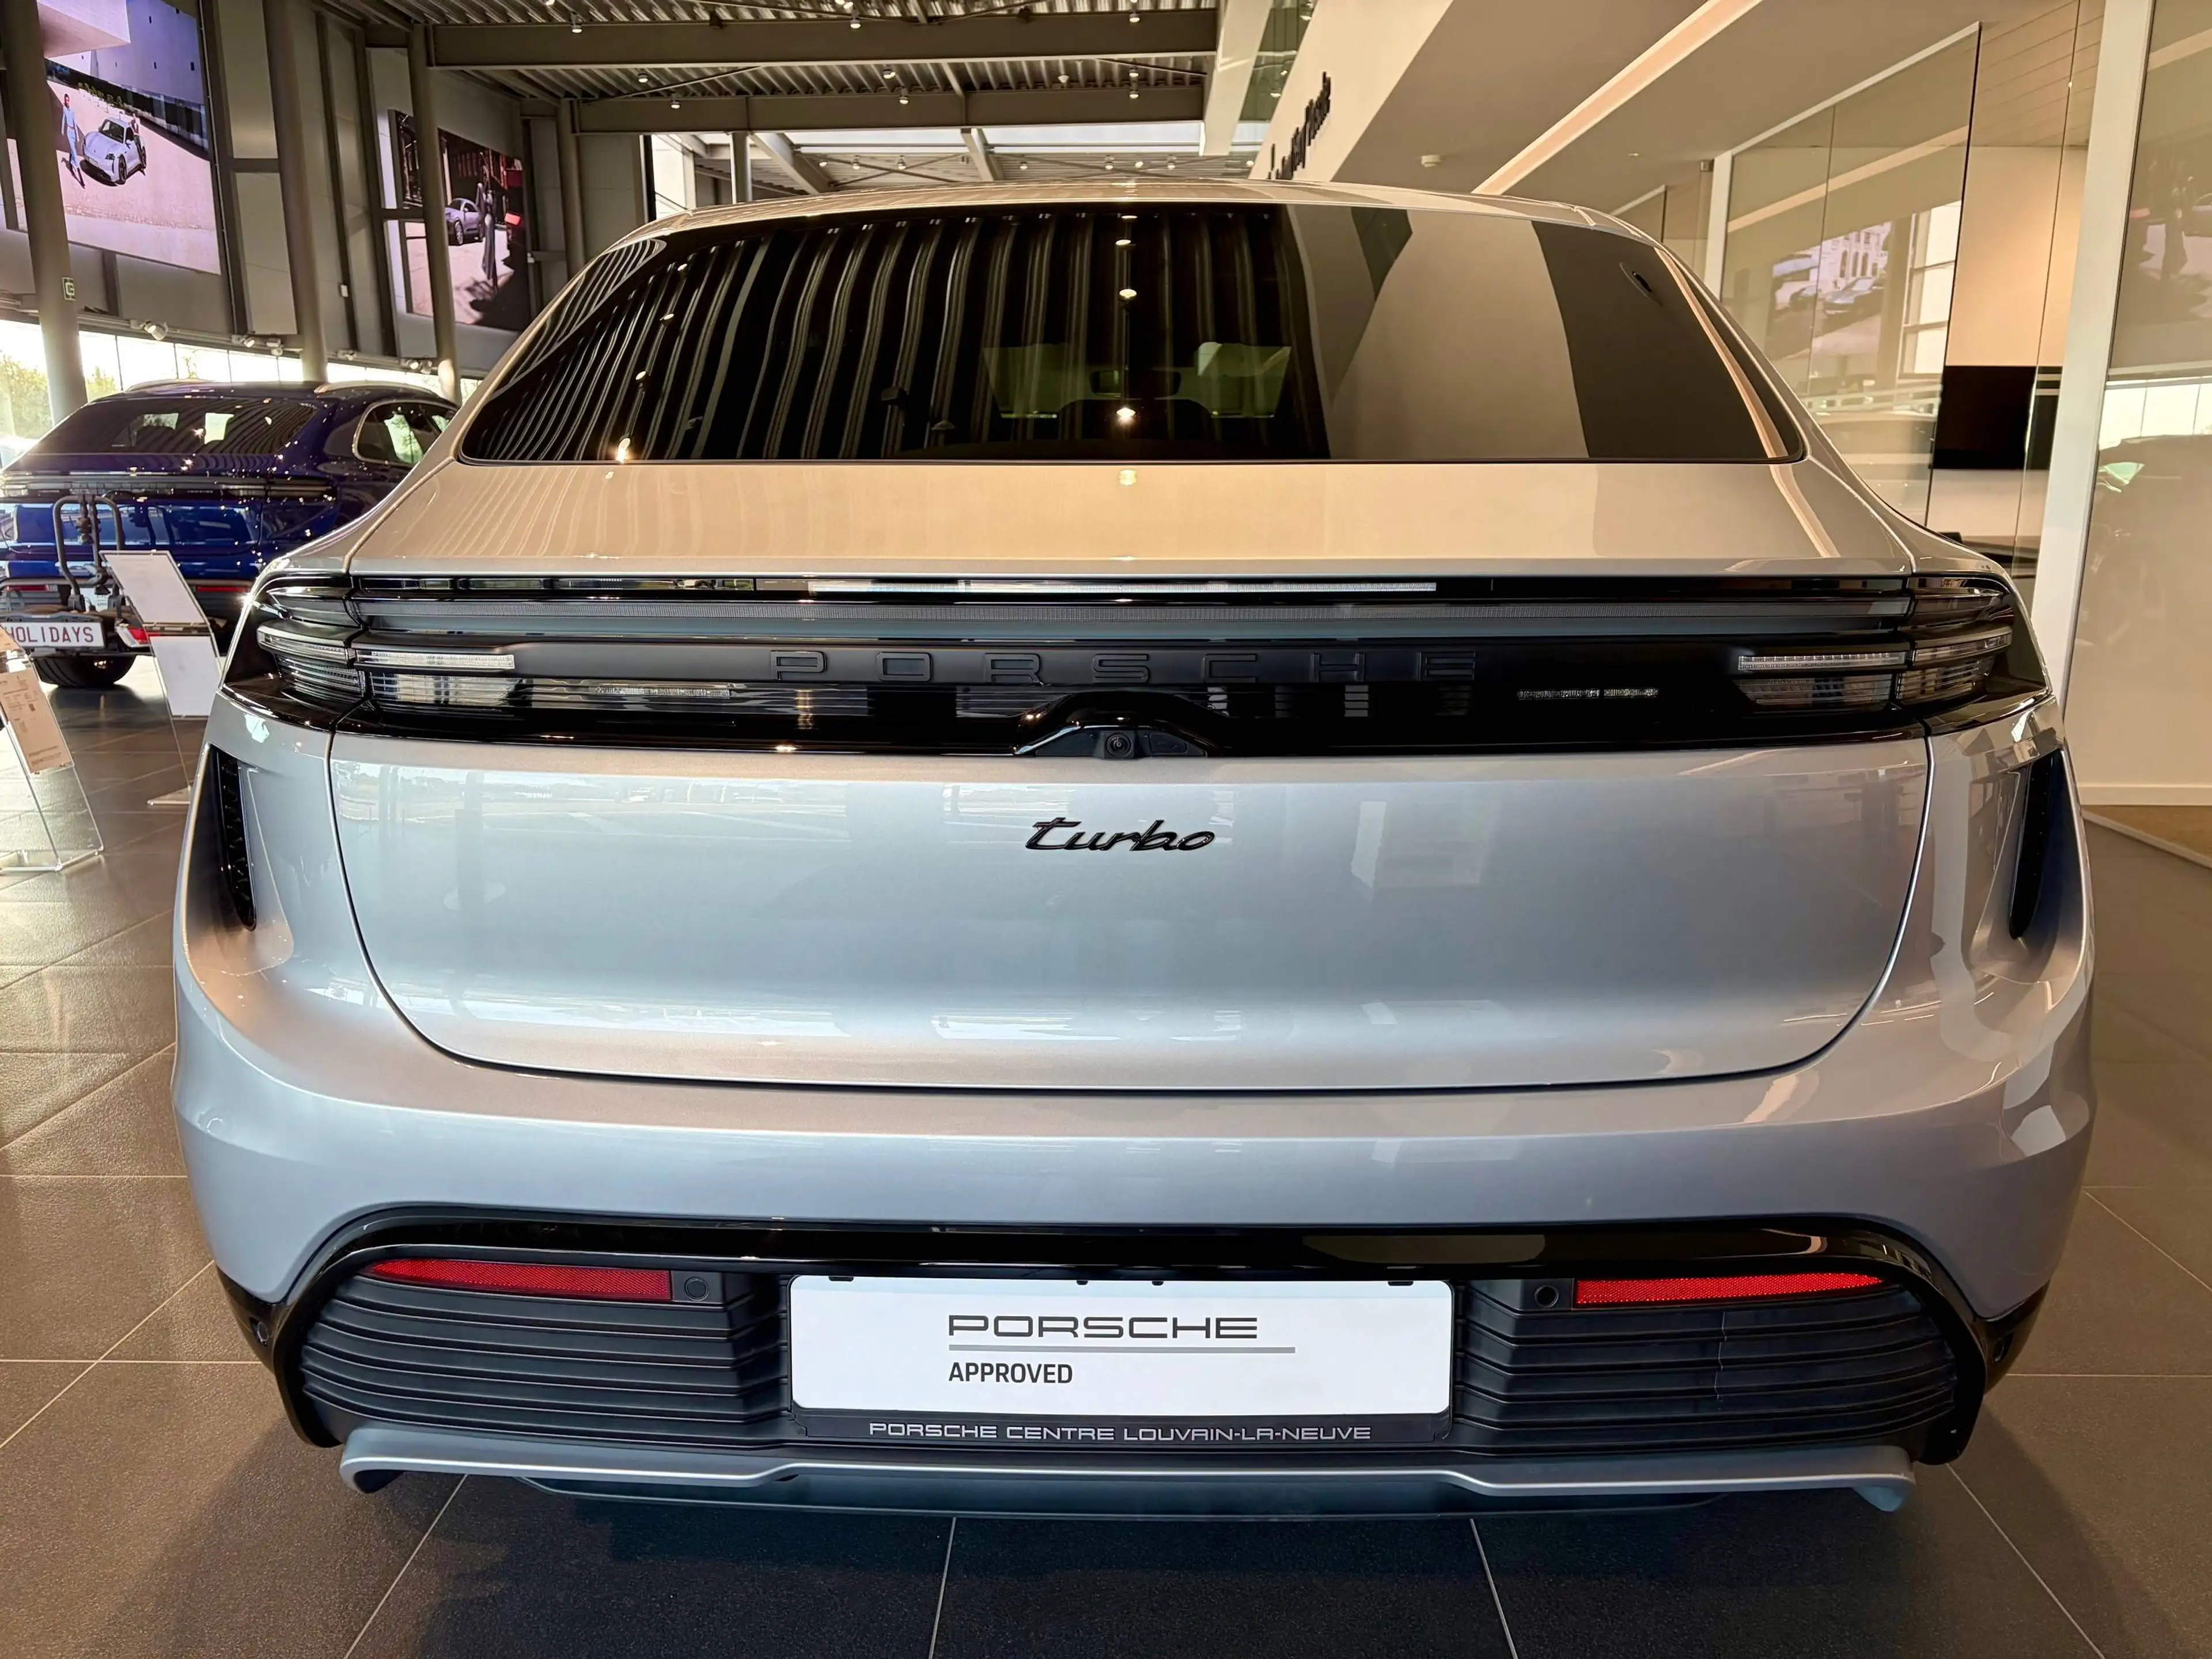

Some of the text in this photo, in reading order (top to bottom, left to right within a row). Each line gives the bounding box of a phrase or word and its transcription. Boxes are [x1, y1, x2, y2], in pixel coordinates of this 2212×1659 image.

[770, 650, 1476, 684] PORSCHE
[1025, 817, 1215, 851] turbo
[948, 1315, 1258, 1340] PORSCHE
[948, 1362, 1073, 1384] APPROVED
[869, 1423, 1371, 1441] PORSCHE CENTRE LOUVAIN-LA-NEUVE
